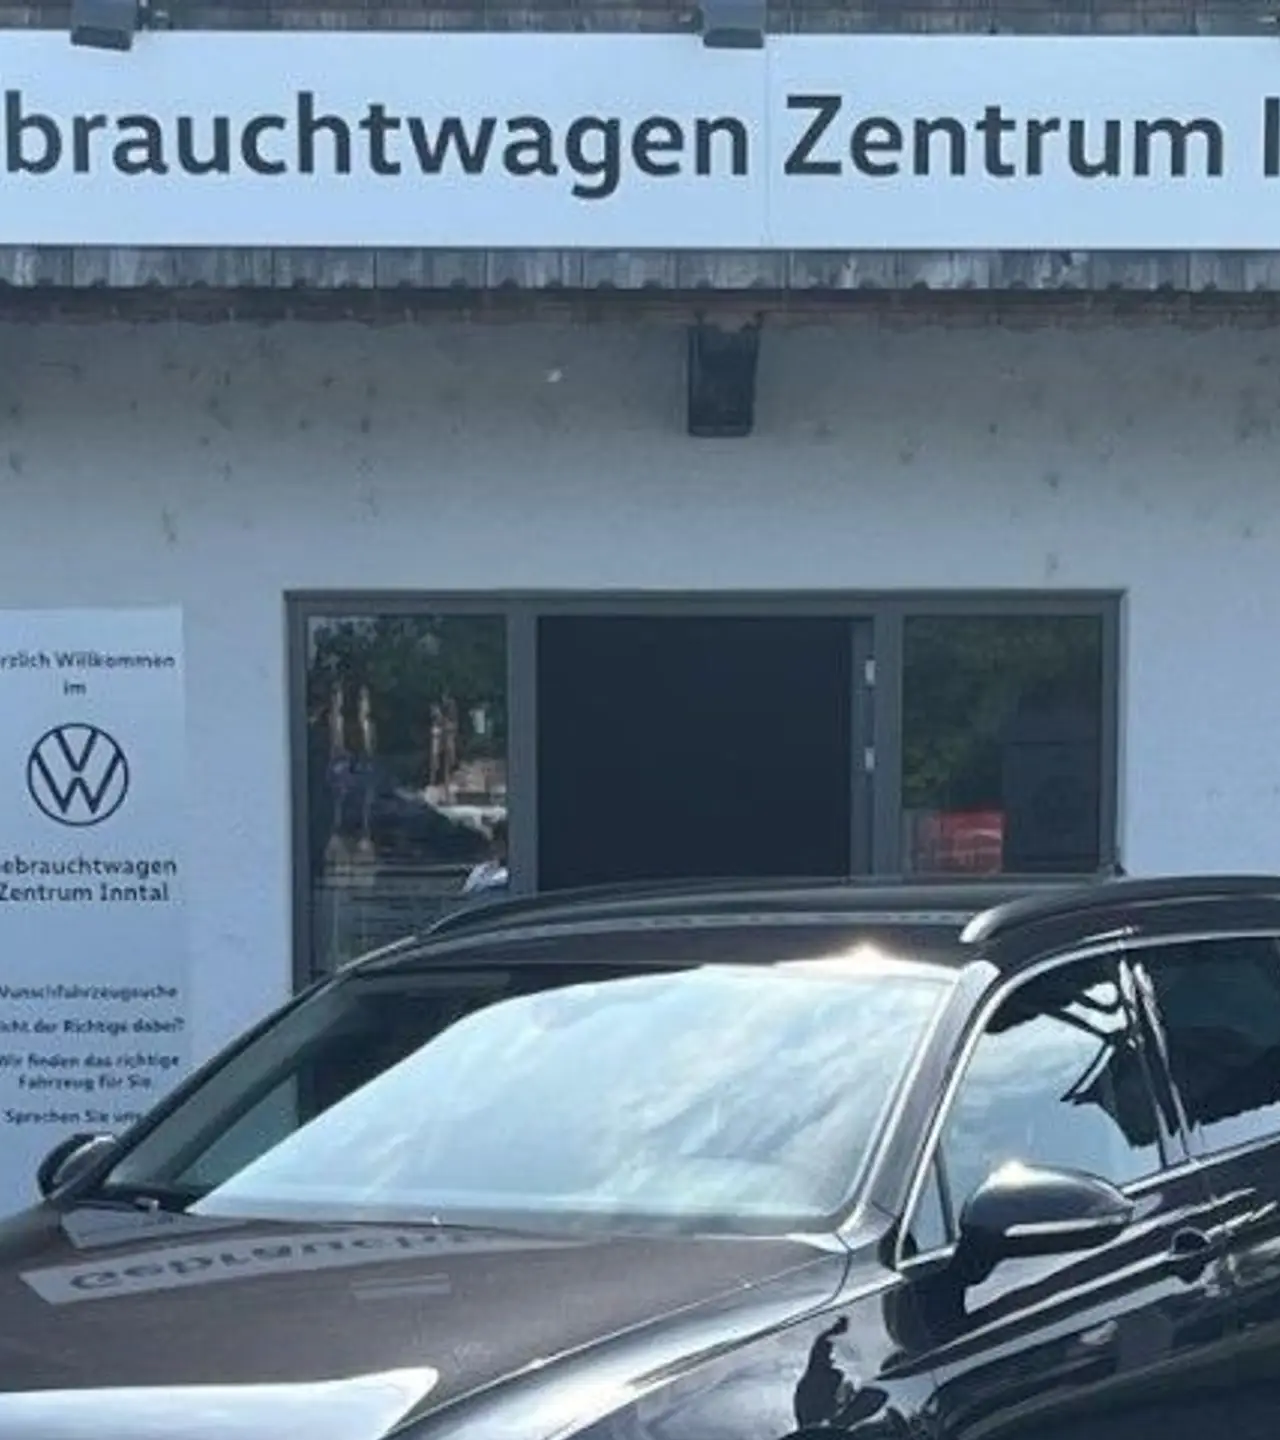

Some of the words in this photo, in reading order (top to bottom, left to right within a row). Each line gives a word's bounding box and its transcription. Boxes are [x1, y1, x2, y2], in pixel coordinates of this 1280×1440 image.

[784, 93, 1224, 178] Zentrum
[55, 652, 175, 669] Willkommen
[64, 681, 86, 695] im
[100, 882, 169, 901] Inntal
[34, 1019, 58, 1033] der
[63, 1019, 127, 1036] Richtige
[133, 1017, 185, 1033] dabei?
[28, 1053, 80, 1068] finden
[84, 1053, 113, 1068] das
[117, 1053, 179, 1069] richtige
[19, 1075, 95, 1092] Fahrzeug
[99, 1074, 122, 1088] für
[4, 1108, 80, 1124] Sprechen
[84, 1109, 109, 1123] Sie
